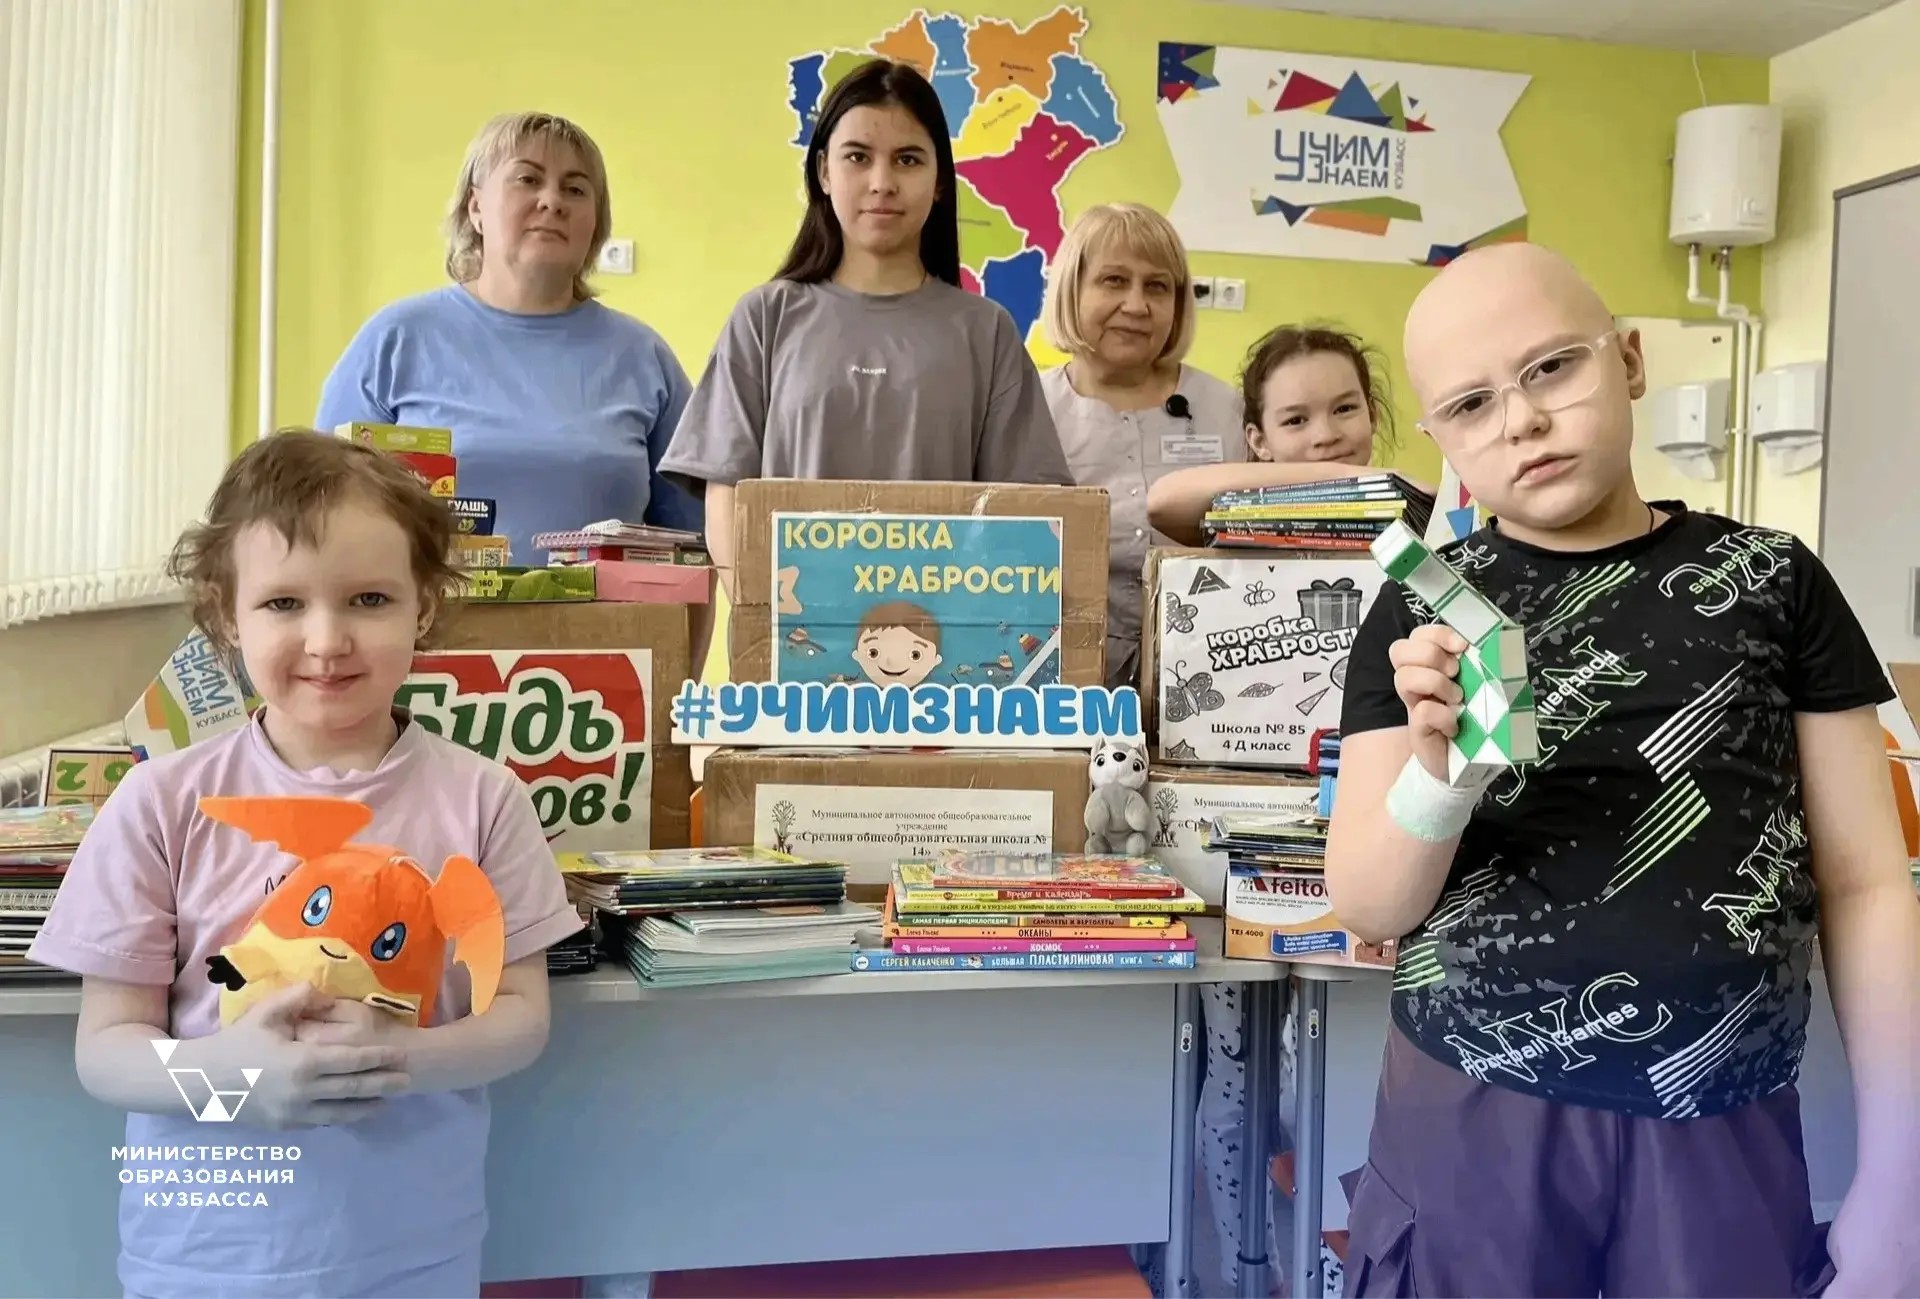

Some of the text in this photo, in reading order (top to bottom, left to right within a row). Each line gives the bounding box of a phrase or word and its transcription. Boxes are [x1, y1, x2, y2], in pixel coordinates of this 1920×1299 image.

[1274, 128, 1390, 182] УЧИМ
[784, 520, 953, 550] КОРОБКА
[854, 565, 1060, 594] ХРАБРОСТИ
[1207, 615, 1317, 649] коробка
[675, 682, 1139, 738] #УЧИМЗНАЕМ
[196, 707, 242, 729] КУЗБАСС
[1211, 723, 1306, 735] Школа № 85
[1222, 740, 1292, 753] 4 Д класс
[1194, 797, 1265, 811] Муниципальное
[811, 809, 1032, 822] Муниципальное автономное общеобразовательное
[896, 822, 948, 832] учреждение
[795, 831, 1048, 845] «Средняя общеобразовательная школа №
[1018, 929, 1052, 938] ОКЕАНЫ
[1030, 943, 1063, 952] КОСМОС
[881, 956, 909, 967] СЕРГЕЙ
[1029, 954, 1114, 966] ПЛАСТИЛИНОВАЯ
[1120, 956, 1143, 965] КНИГА
